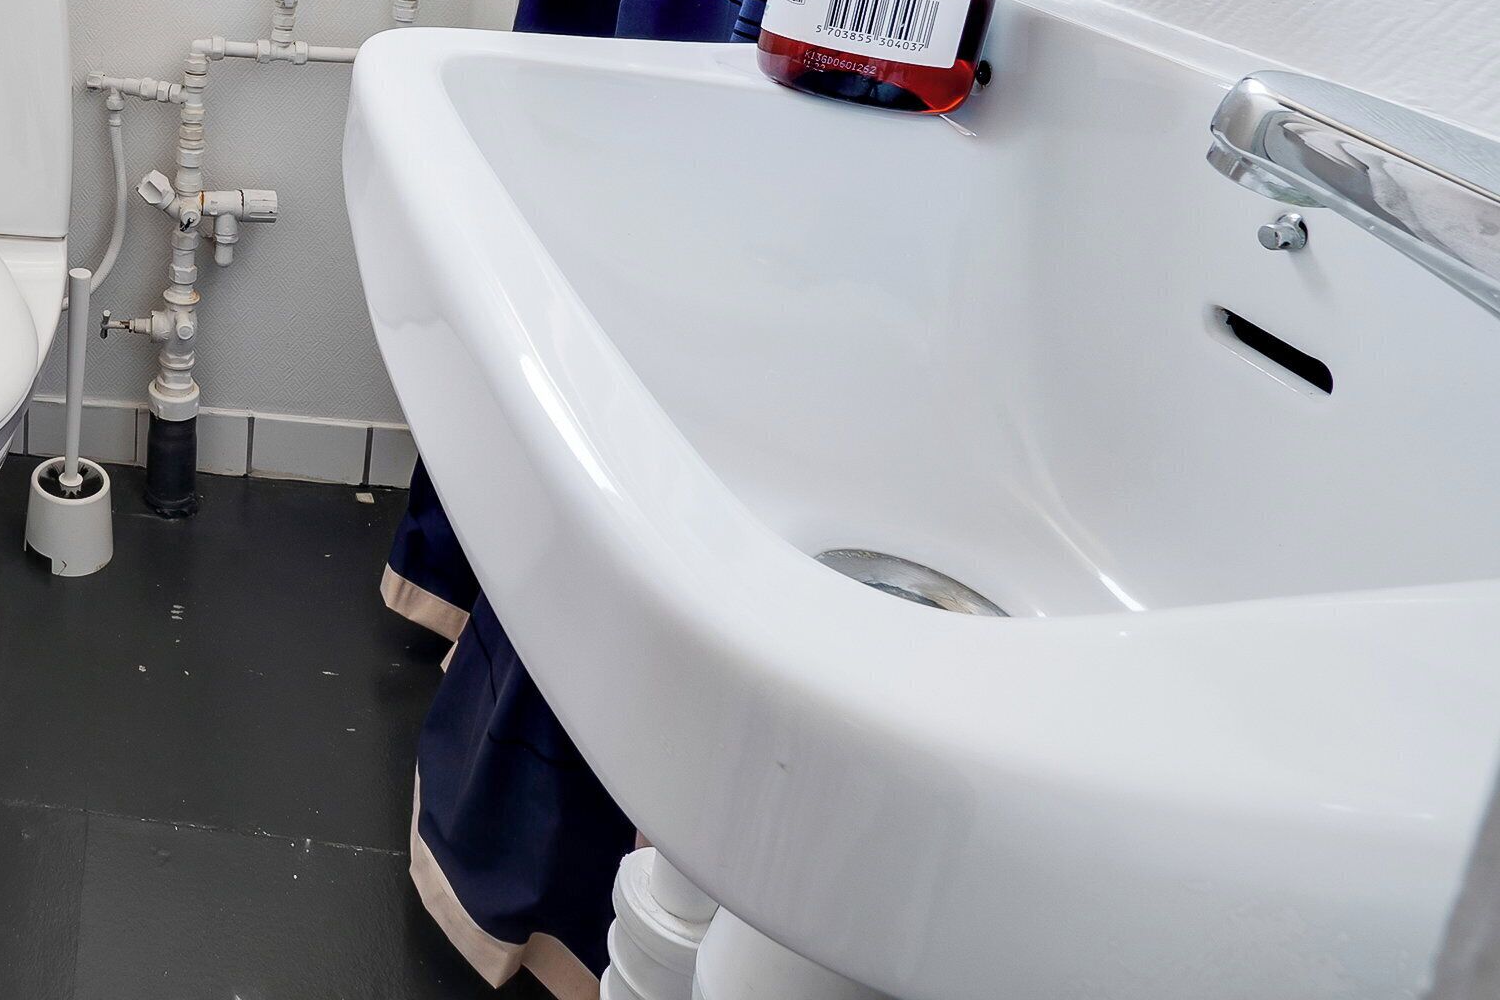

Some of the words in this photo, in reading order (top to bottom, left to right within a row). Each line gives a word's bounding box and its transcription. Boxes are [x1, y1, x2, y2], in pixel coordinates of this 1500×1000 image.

[815, 24, 822, 33] 5
[826, 27, 872, 43] 703855
[878, 37, 925, 52] 304037
